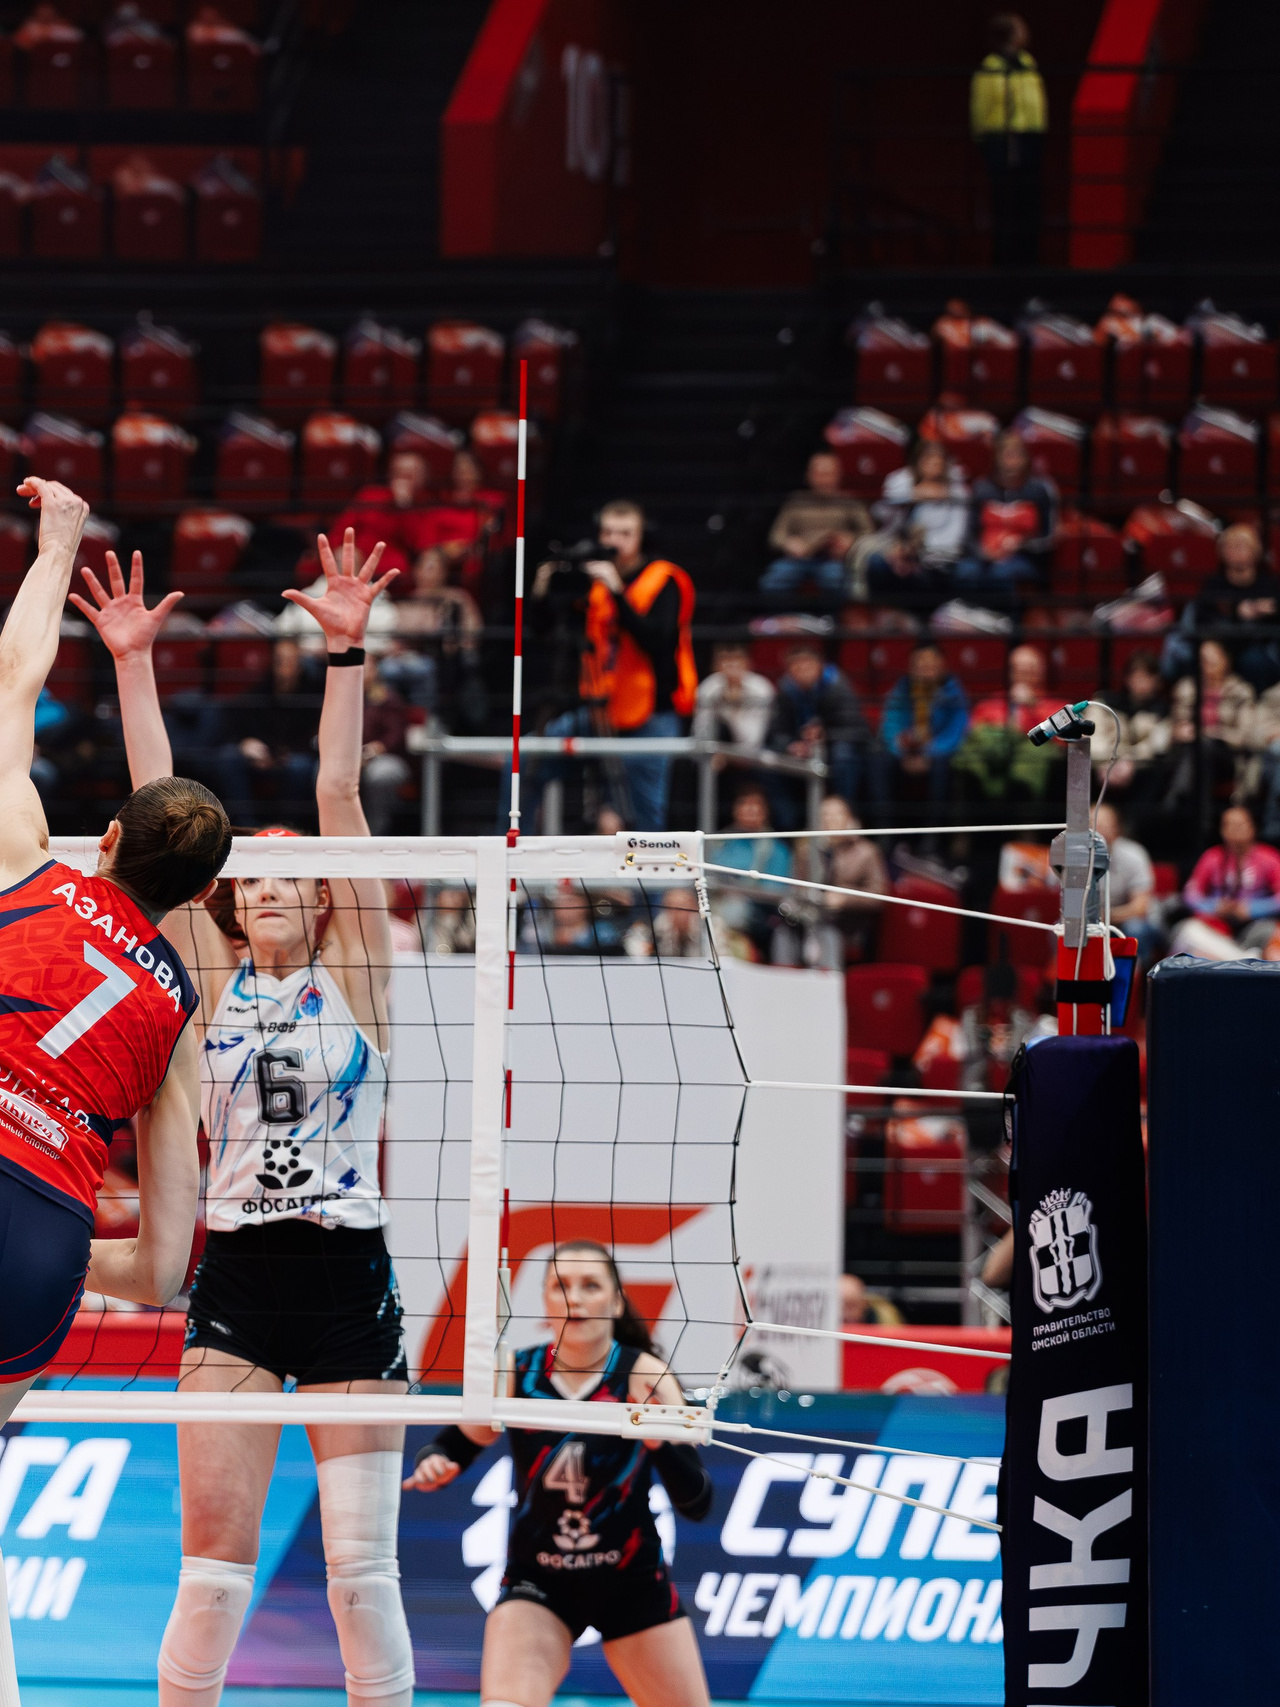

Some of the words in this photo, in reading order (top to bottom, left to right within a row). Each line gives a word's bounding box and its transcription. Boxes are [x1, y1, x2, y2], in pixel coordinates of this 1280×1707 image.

[639, 839, 681, 849] Senoh
[52, 882, 183, 1013] АЗАНОВА
[36, 939, 138, 1060] 7
[253, 1046, 308, 1127] 6
[1031, 1330, 1070, 1351] ОМСКОЙ
[1071, 1322, 1116, 1340] ОБЛАСТИ
[1033, 1307, 1111, 1337] ПРАВИТЕЛЬСТВО
[542, 1441, 589, 1504] 4
[536, 1550, 621, 1570] ФОСАГРО
[1026, 1382, 1134, 1707] ЧКА
